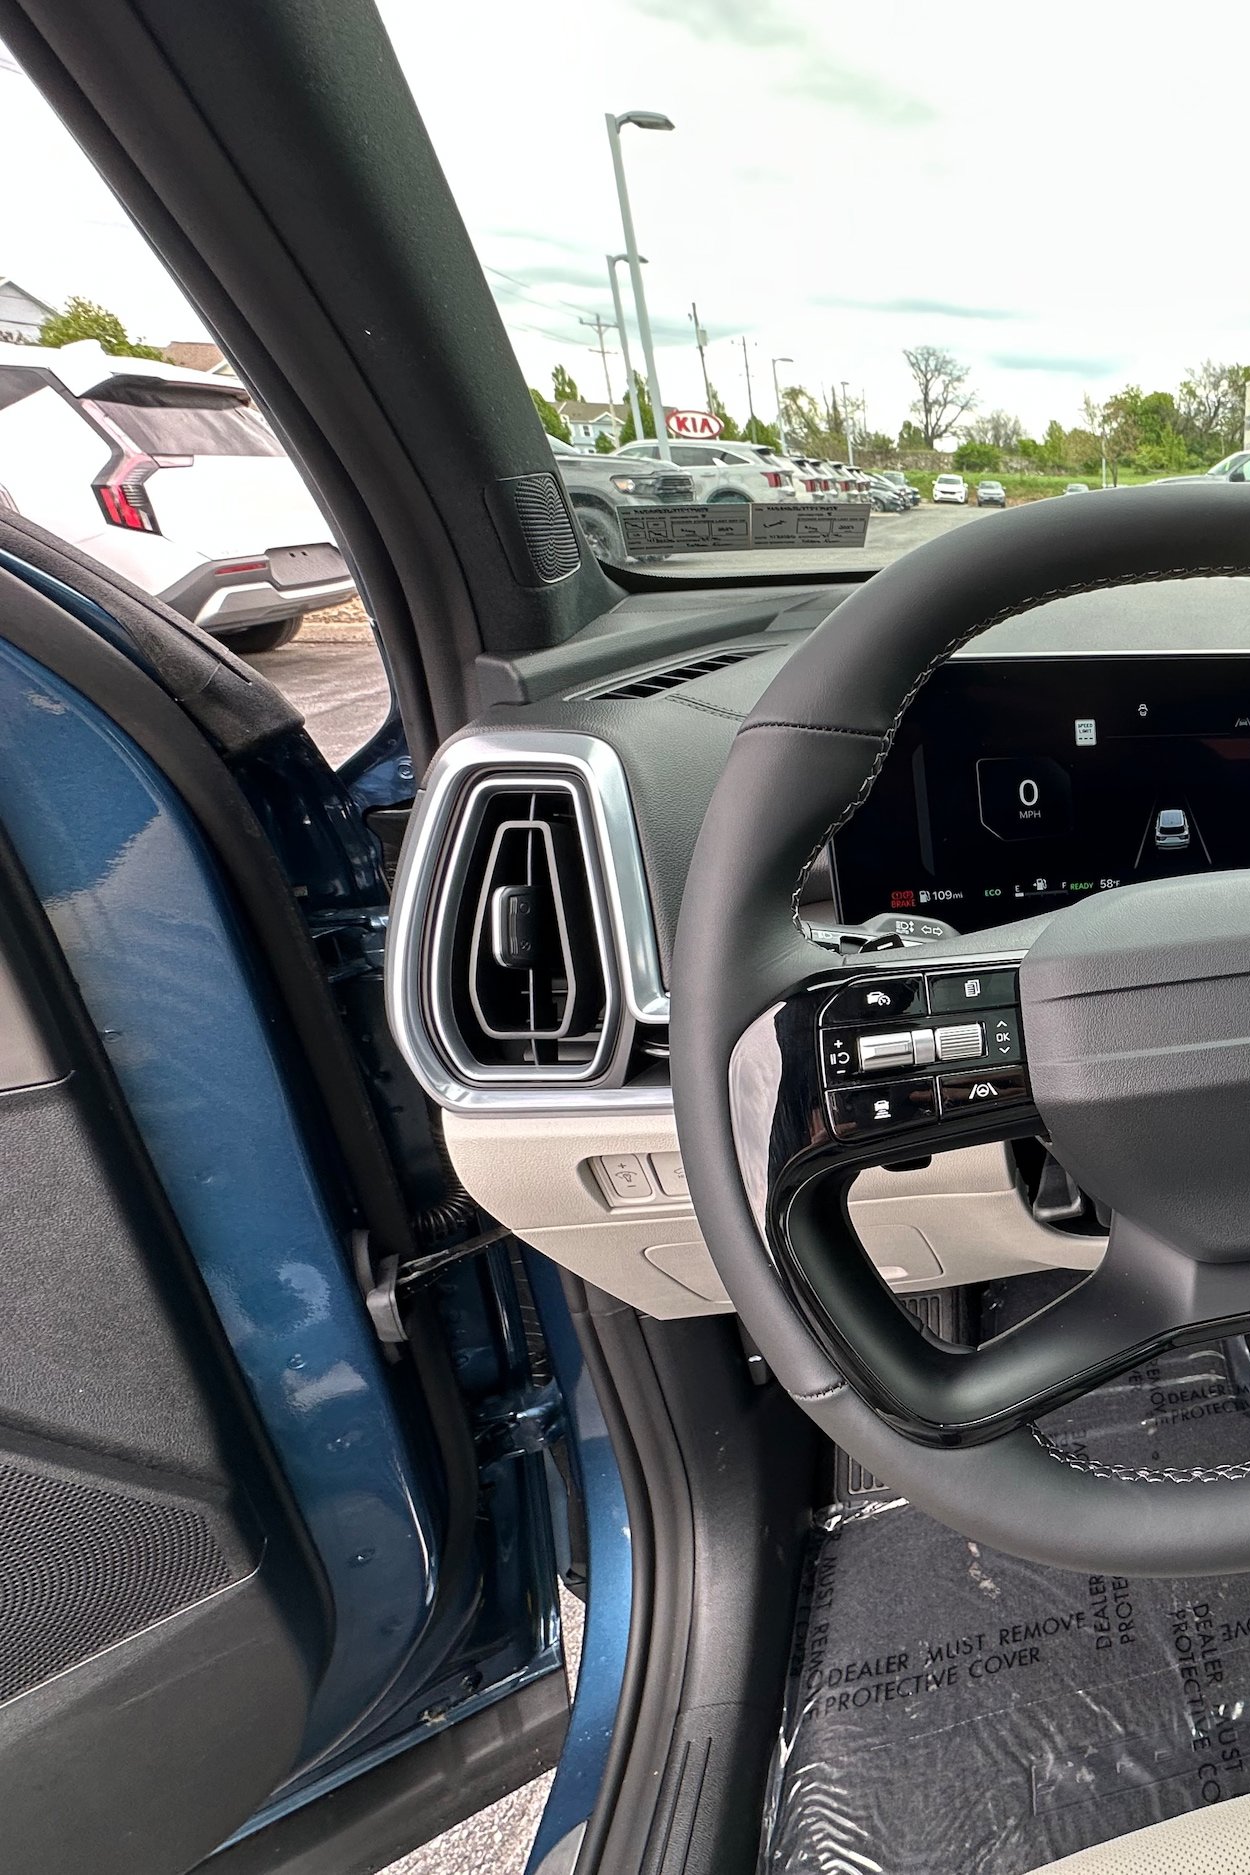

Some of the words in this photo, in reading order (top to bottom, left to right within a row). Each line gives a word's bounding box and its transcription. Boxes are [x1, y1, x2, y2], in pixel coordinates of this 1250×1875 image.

[676, 414, 712, 433] KIA
[1019, 779, 1039, 806] 0
[1019, 810, 1041, 819] MPH
[984, 888, 1002, 897] ECO
[1015, 885, 1020, 893] E
[1070, 882, 1094, 891] READY
[891, 899, 917, 908] BRAKE
[996, 1032, 1010, 1042] OK
[1167, 1384, 1225, 1404] DEALER
[1089, 1575, 1113, 1650] DEALER
[828, 1653, 910, 1688] DEALER
[924, 1634, 986, 1666] MUST
[999, 1612, 1086, 1645] REMOVE
[1193, 1603, 1224, 1686] DEALER
[825, 1665, 958, 1714] PROTECTIVE
[968, 1647, 1040, 1679] COVER
[1171, 1610, 1211, 1751] PROTECTIVE
